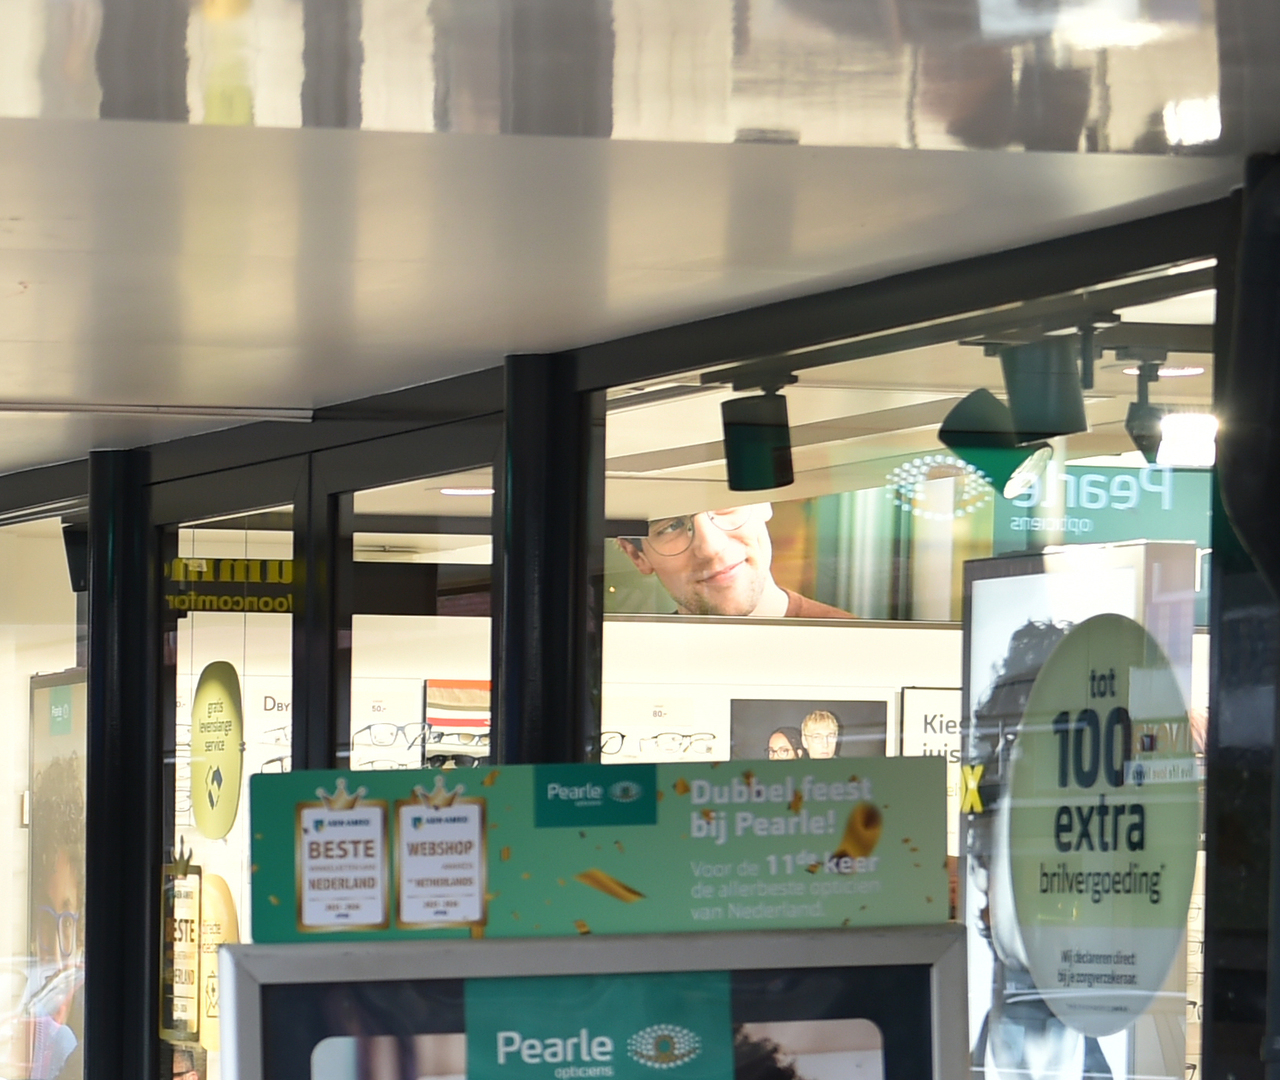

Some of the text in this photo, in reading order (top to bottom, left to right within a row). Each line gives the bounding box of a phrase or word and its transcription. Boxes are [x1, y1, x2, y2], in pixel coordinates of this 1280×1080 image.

[1089, 667, 1115, 698] tot
[208, 698, 224, 718] gratis
[199, 719, 232, 737] levenslange
[205, 737, 225, 752] service
[547, 783, 603, 800] Pearle
[691, 776, 873, 805] Dubbel feest
[691, 810, 835, 845] bij Pearle!
[1054, 794, 1145, 852] extra
[308, 840, 374, 859] BESTE
[407, 841, 473, 857] WEBSHOP
[691, 861, 730, 878] Voor
[737, 859, 758, 876] de
[824, 854, 878, 873] keer
[308, 877, 376, 891] NEDERLAND
[414, 878, 473, 888] NETHERLANDS
[691, 877, 880, 898] de allerbeste opticien
[691, 900, 825, 920] van Nederland.
[497, 1028, 614, 1064] Pearle
[554, 1066, 614, 1080] opticiens
